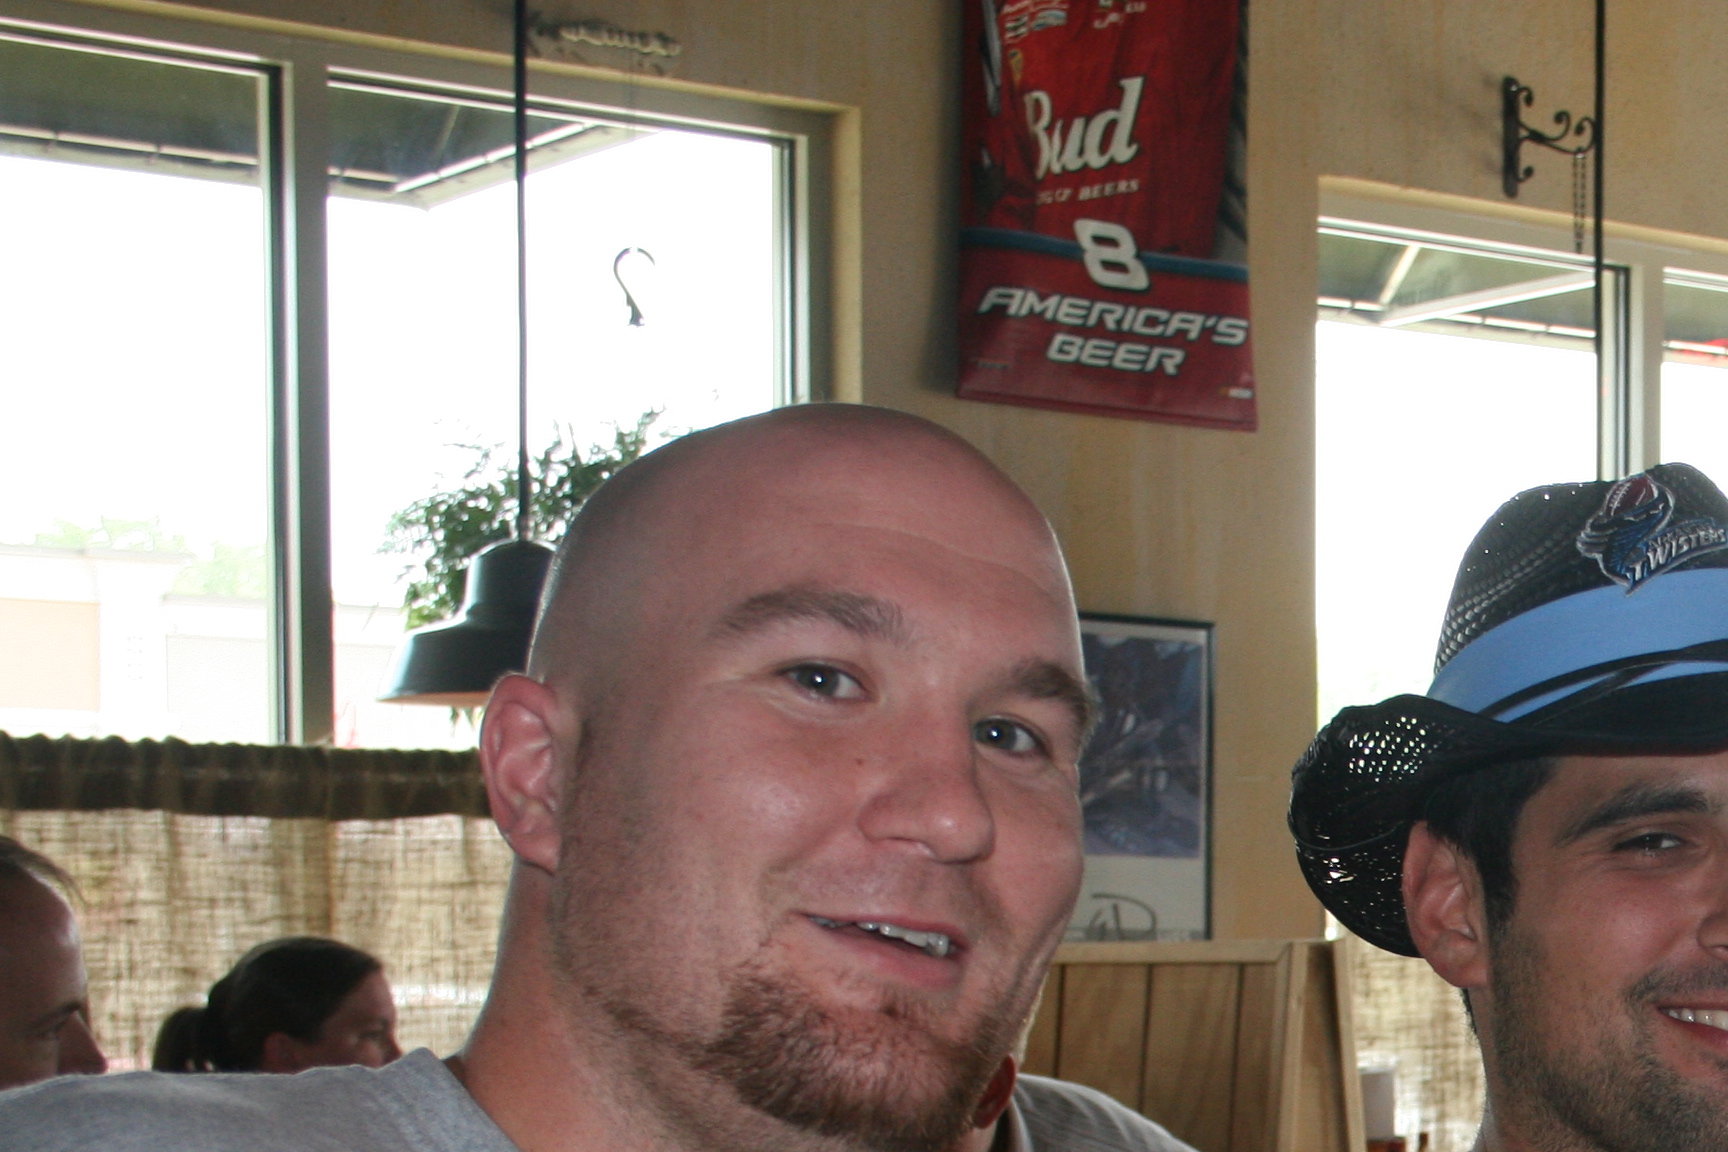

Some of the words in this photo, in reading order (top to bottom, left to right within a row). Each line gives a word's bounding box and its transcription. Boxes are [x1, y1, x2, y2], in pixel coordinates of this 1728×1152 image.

[1023, 76, 1145, 181] Bud
[1078, 179, 1140, 201] BEERS
[1073, 217, 1150, 291] 8
[978, 286, 1249, 346] AMERICA'S
[1046, 332, 1186, 376] BEER
[1625, 527, 1727, 582] TWISTERS
